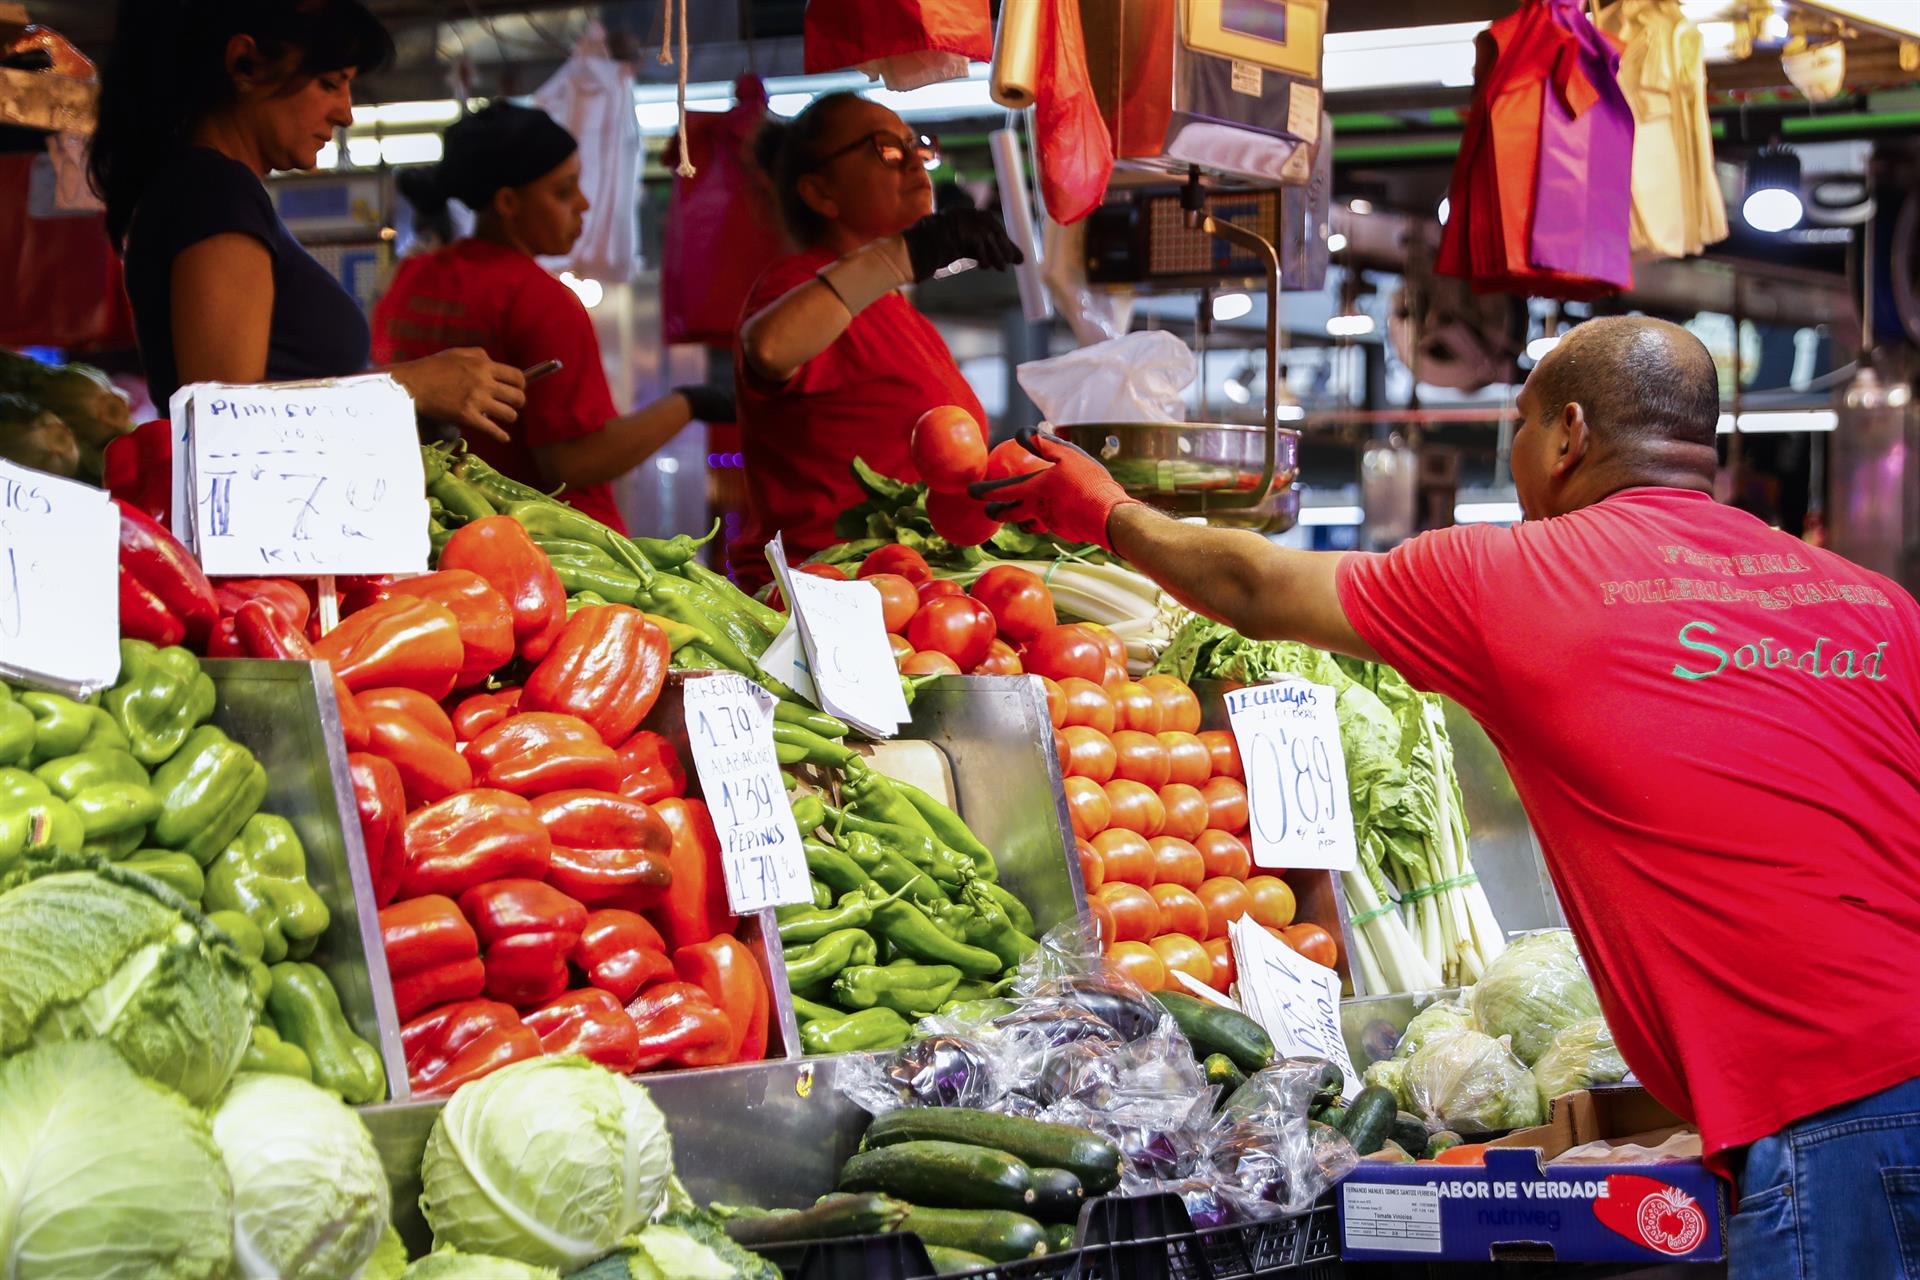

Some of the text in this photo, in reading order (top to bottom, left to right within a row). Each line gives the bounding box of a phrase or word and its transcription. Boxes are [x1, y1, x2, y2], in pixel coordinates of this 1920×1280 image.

[1229, 687, 1317, 715] LECHUGAS
[1251, 727, 1335, 844] 0'89
[729, 823, 785, 853] PEPINOS
[1493, 1181, 1518, 1198] DE
[1521, 1181, 1610, 1199] VERDADE
